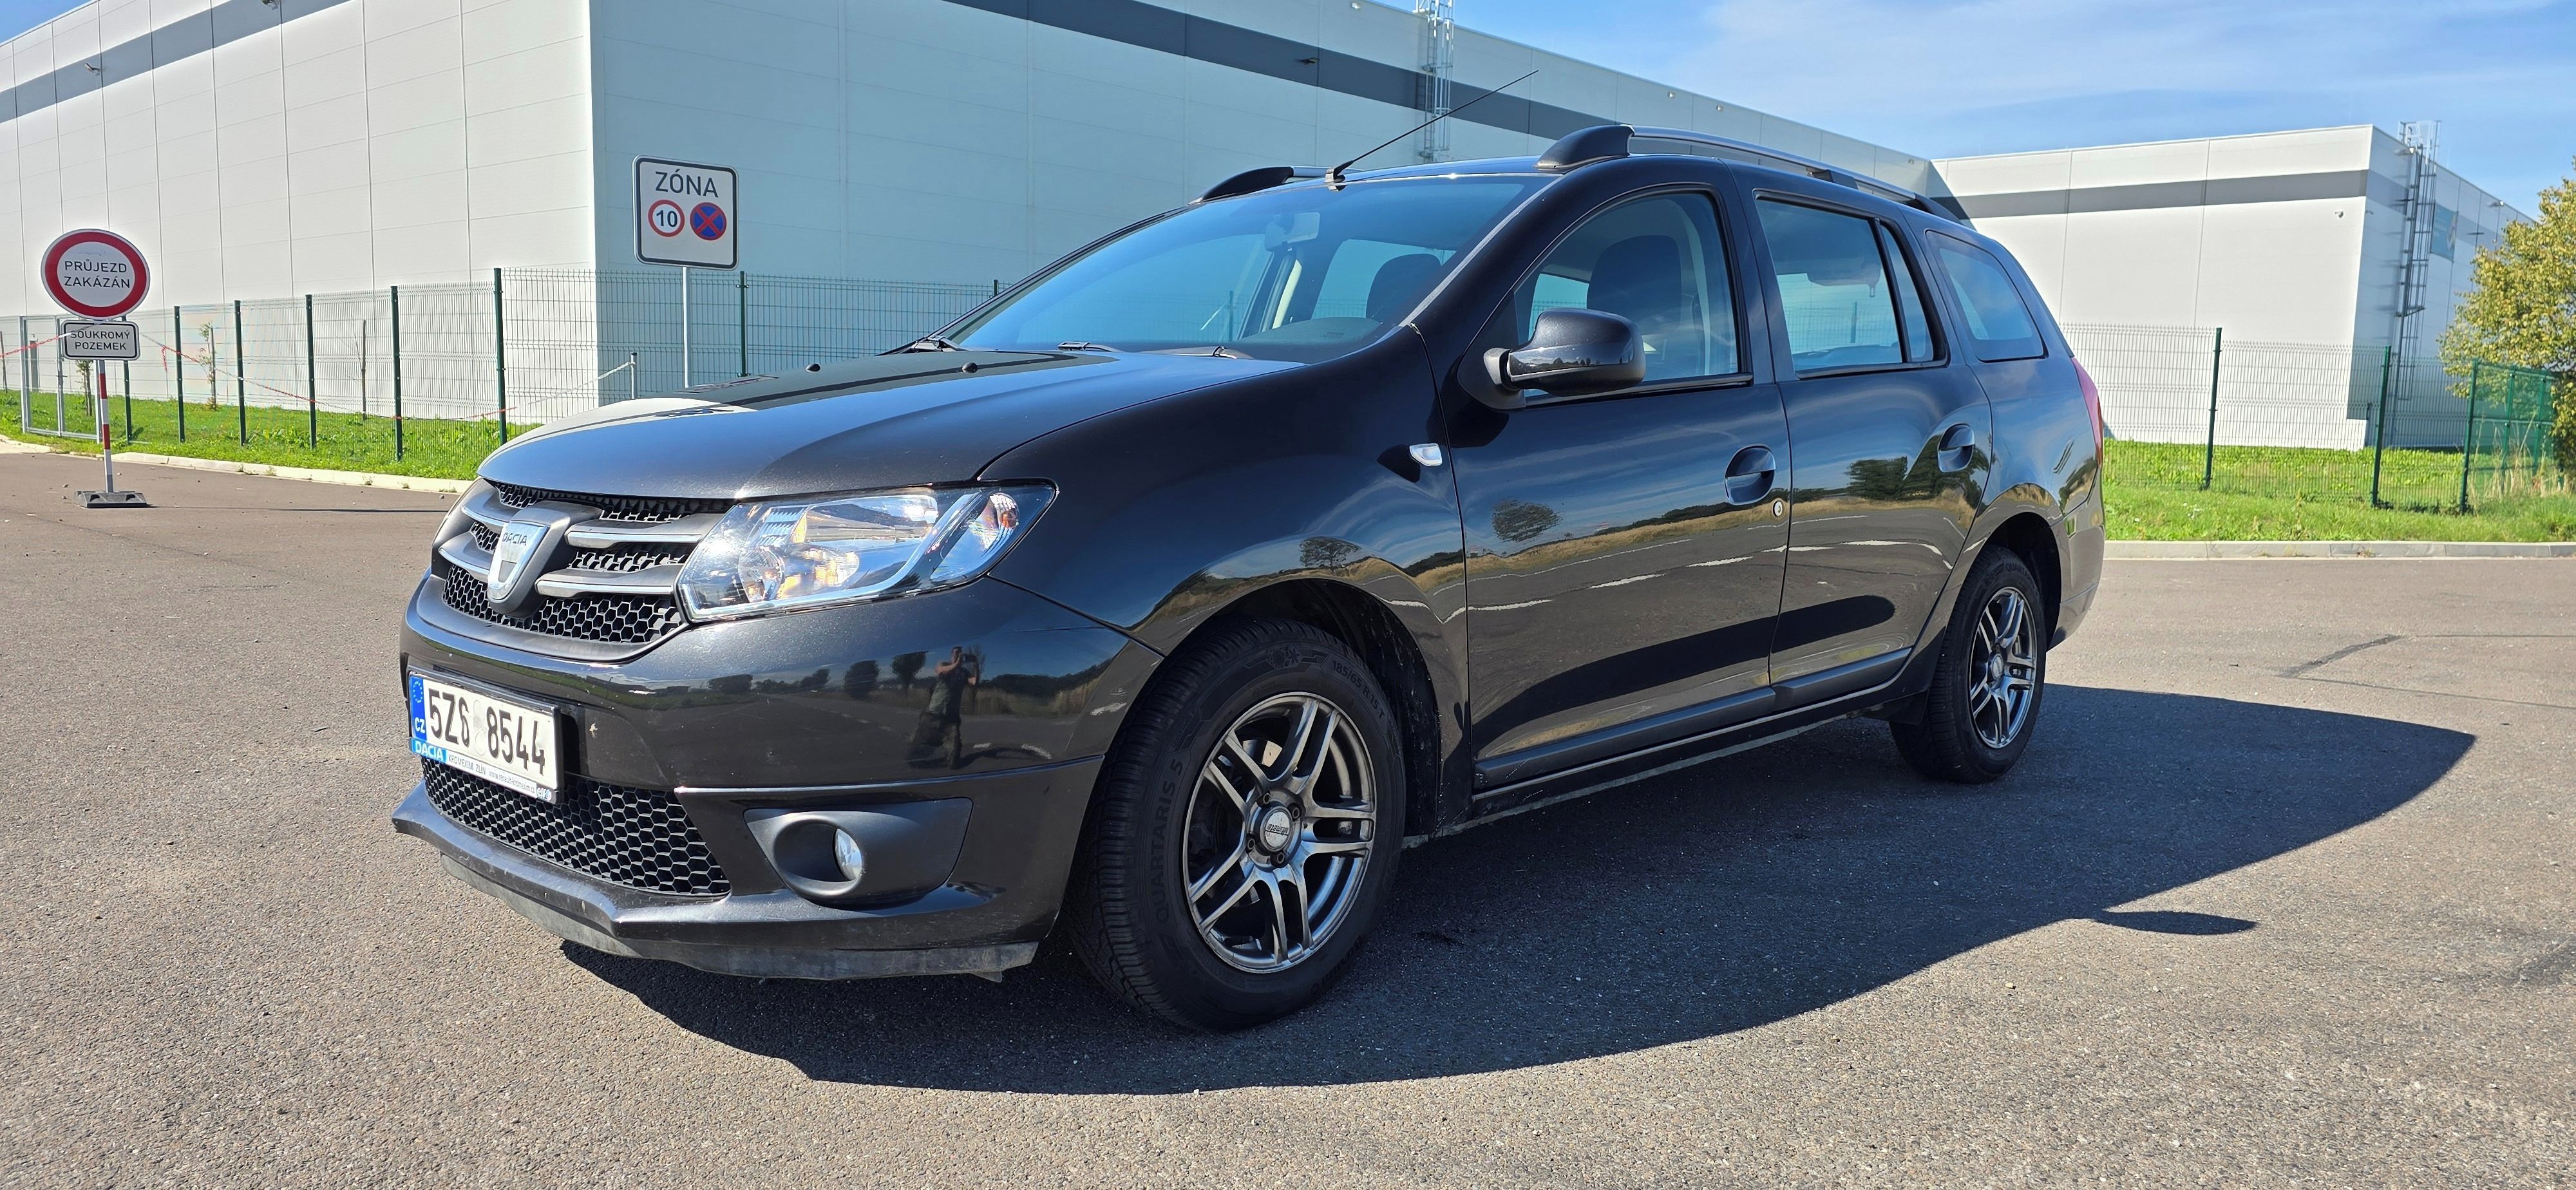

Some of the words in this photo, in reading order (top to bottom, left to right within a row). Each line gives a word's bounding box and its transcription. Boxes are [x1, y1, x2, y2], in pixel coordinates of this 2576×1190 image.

[655, 169, 719, 198] ZÓNA
[656, 210, 678, 228] 10
[64, 258, 127, 273] PRŮJEZD
[64, 275, 130, 288] ZAKÁZÁN
[70, 330, 130, 339] SOUKROMÝ
[75, 341, 127, 350] POZEMEK
[502, 532, 527, 547] DACIA
[1332, 660, 1362, 688] 185/65
[1362, 685, 1370, 698] R
[1370, 695, 1379, 709] 15
[1379, 708, 1385, 719] T
[414, 717, 426, 733] CZ
[428, 688, 470, 748] 5Z6
[486, 706, 545, 777] 8544
[415, 741, 444, 760] DACIA
[1149, 779, 1175, 925] QUARTARIS
[1169, 759, 1184, 777] 5
